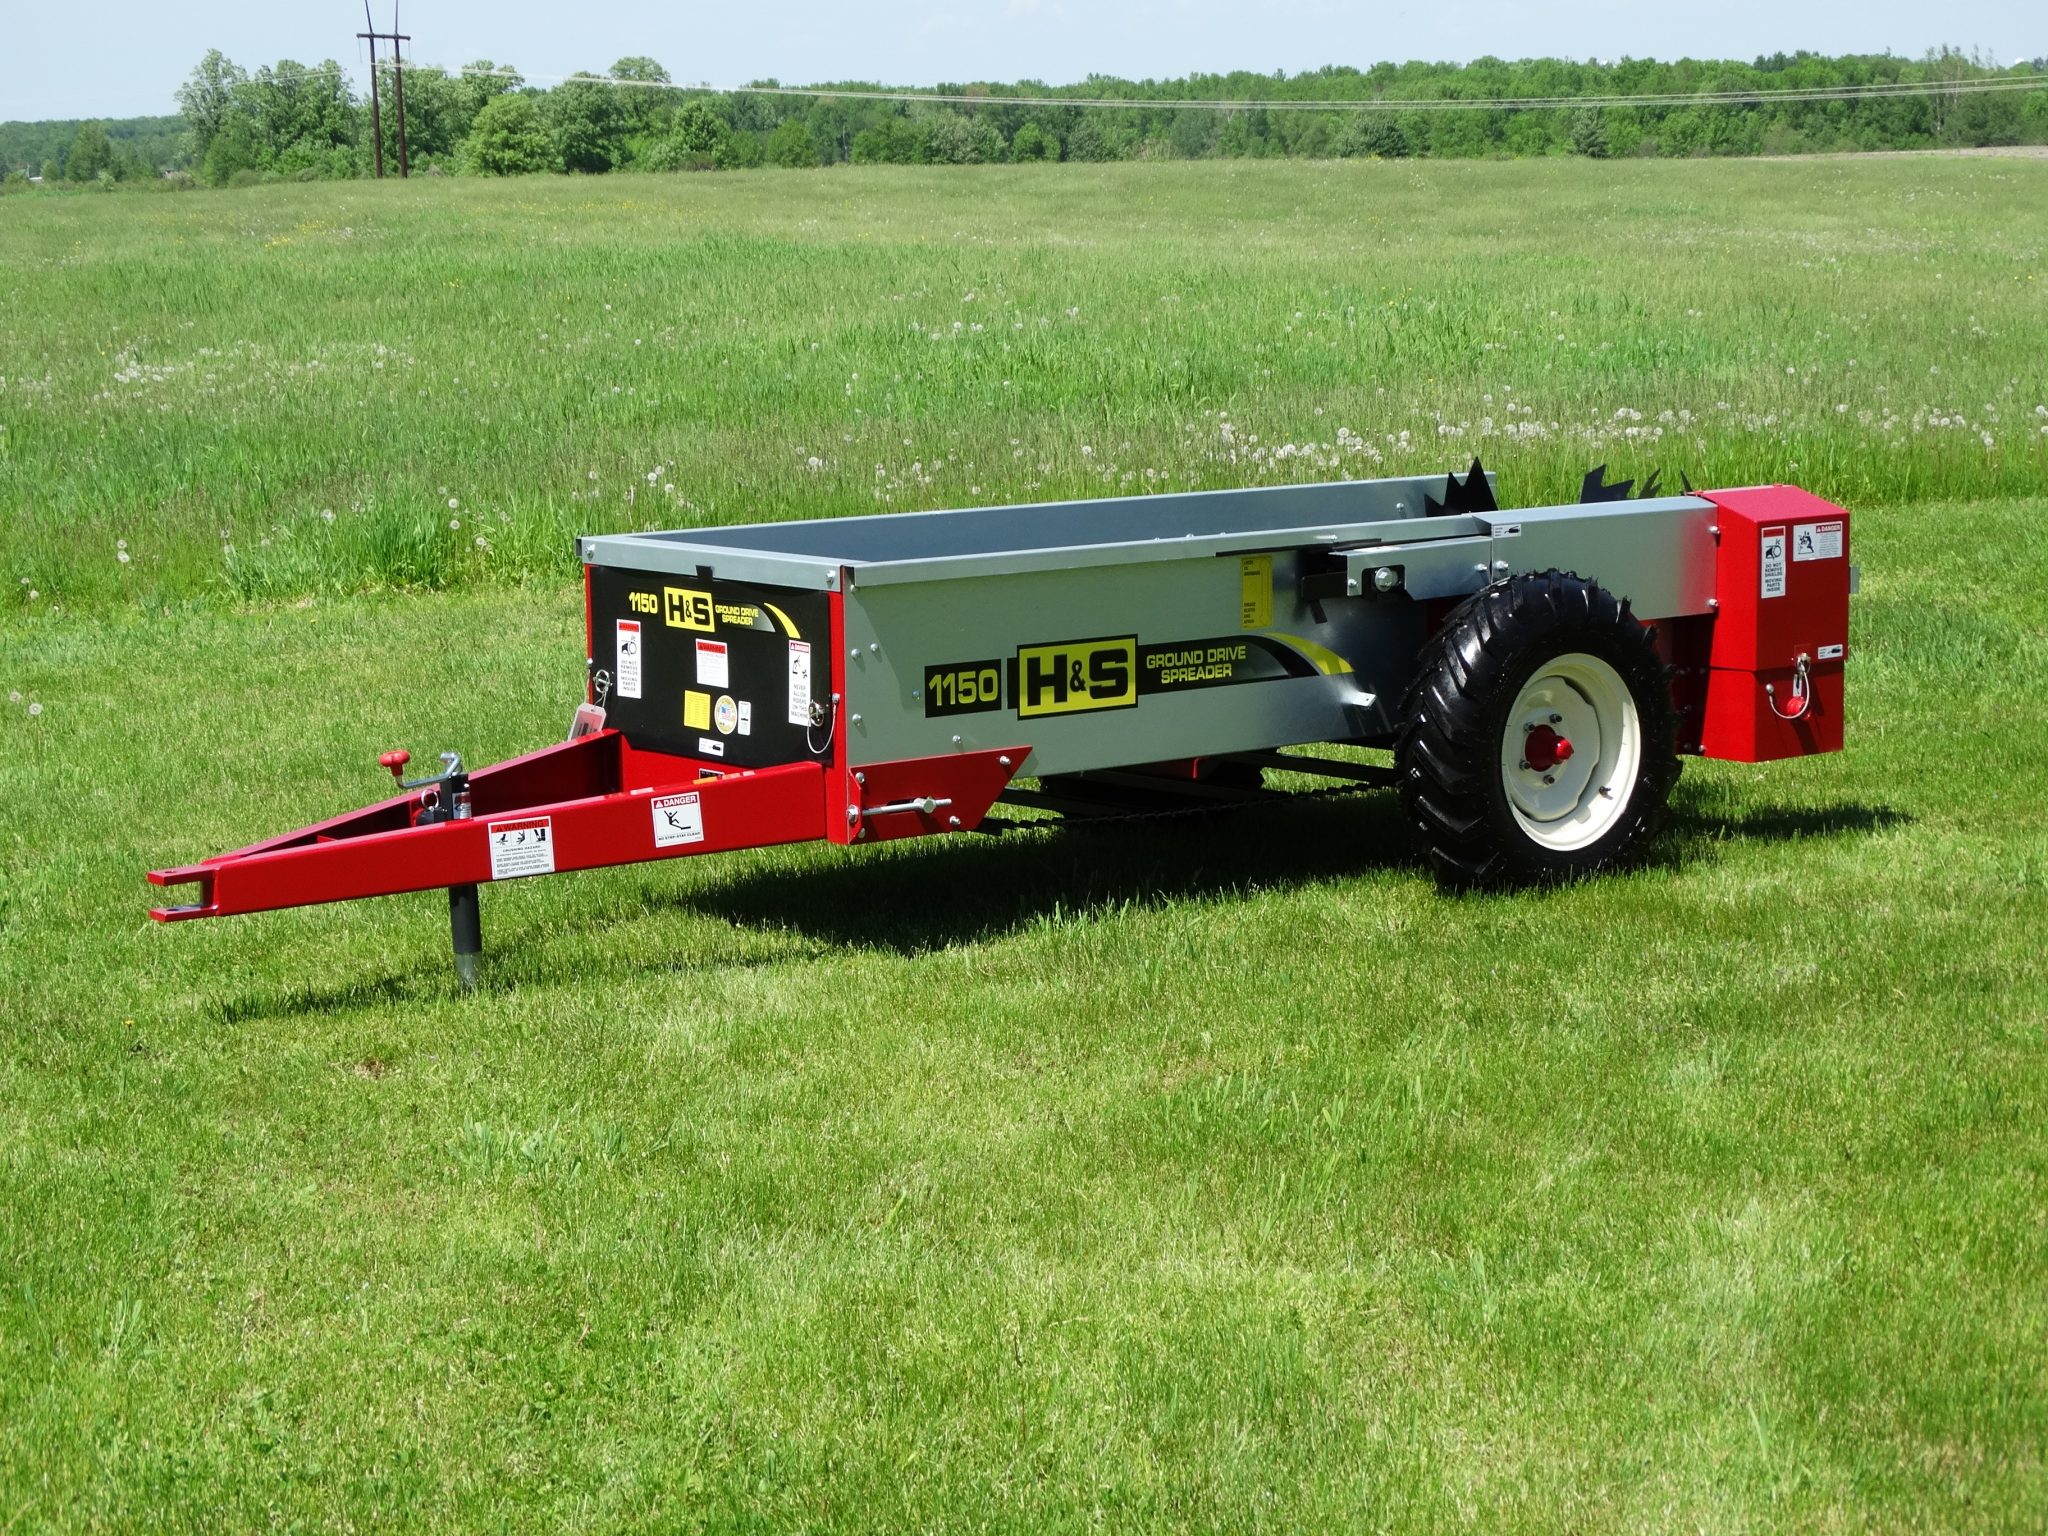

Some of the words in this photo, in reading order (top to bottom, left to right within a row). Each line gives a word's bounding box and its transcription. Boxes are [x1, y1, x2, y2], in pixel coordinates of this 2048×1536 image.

[628, 591, 658, 614] 1150
[668, 593, 711, 626] H&S
[715, 605, 740, 616] GROUND
[740, 606, 759, 617] DRIVE
[722, 614, 753, 626] SPREADER
[1146, 649, 1204, 669] GROUND
[1207, 645, 1246, 663] DRIVE
[1026, 648, 1129, 706] H&S
[1161, 664, 1232, 684] SPREADER
[928, 669, 999, 707] 1150
[663, 795, 697, 807] DANGER
[505, 819, 544, 830] WARNING
